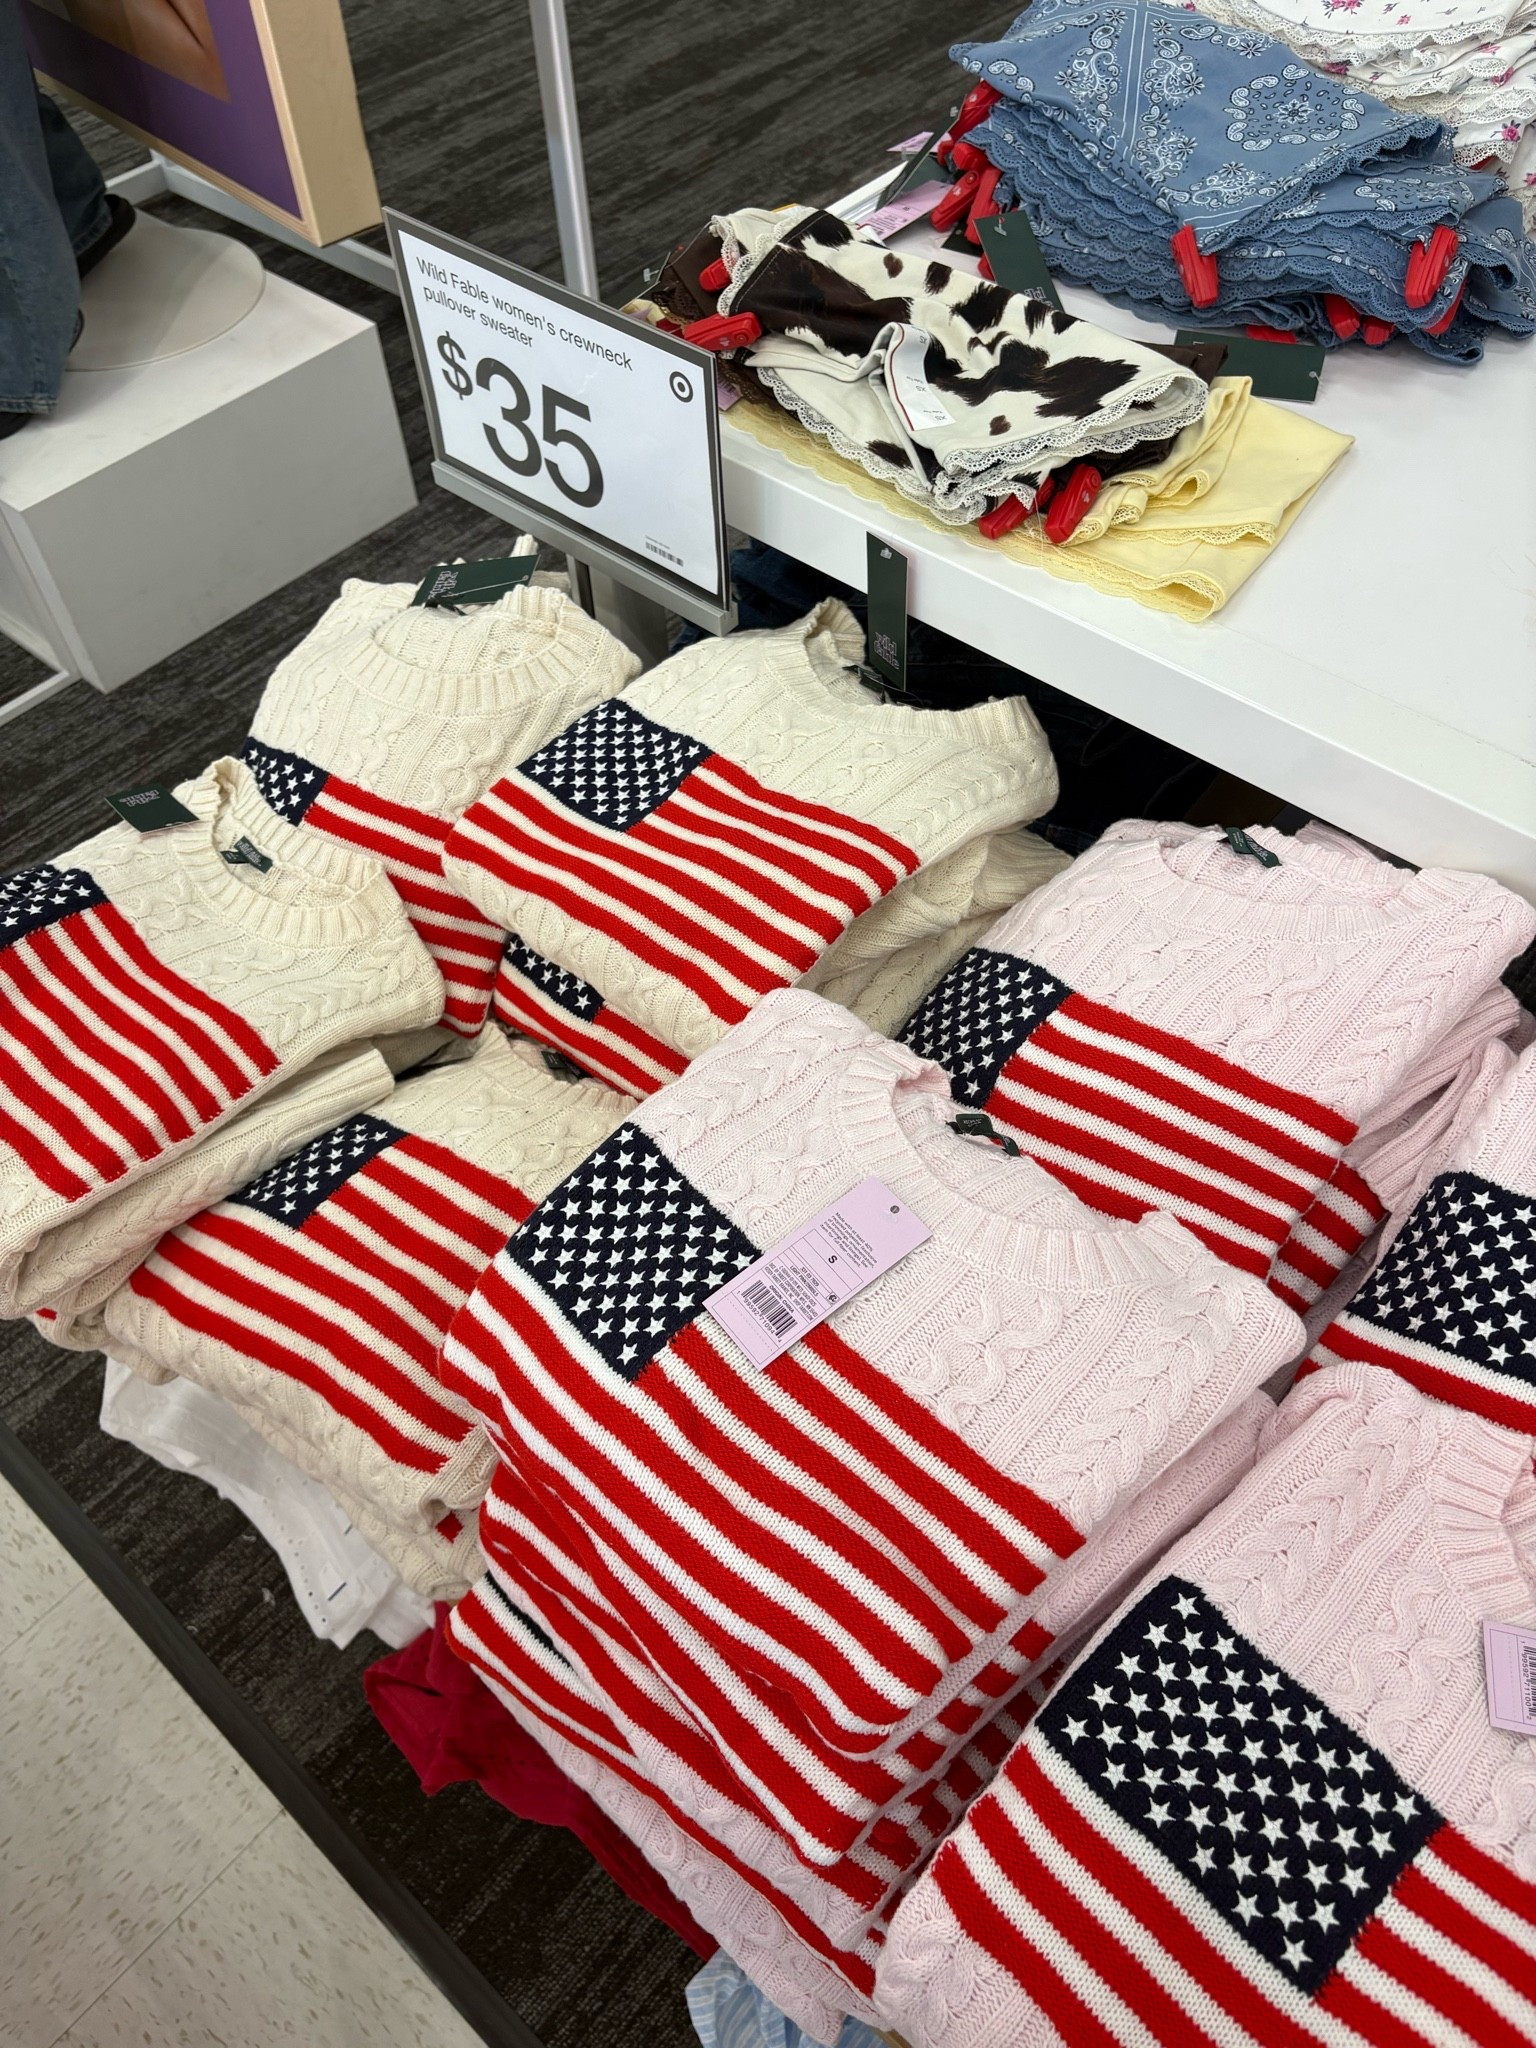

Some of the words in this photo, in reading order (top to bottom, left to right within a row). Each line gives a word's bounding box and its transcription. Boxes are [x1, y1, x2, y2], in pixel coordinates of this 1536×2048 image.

[416, 257, 448, 285] Wild
[450, 273, 489, 303] Fable
[492, 295, 555, 336] women's
[559, 328, 633, 371] crewneck
[423, 286, 476, 321] pullover
[480, 312, 533, 348] sweater
[436, 330, 604, 509] $35
[819, 1223, 828, 1233] item
[837, 1243, 848, 1253] fiber
[830, 1215, 846, 1230] recycled
[844, 1229, 861, 1246] polyester
[834, 1212, 845, 1222] Made
[843, 1221, 853, 1230] with
[855, 1233, 865, 1243] least
[841, 1239, 849, 1247] and
[827, 1254, 838, 1264] S
[742, 1298, 759, 1316] 99592
[758, 1316, 775, 1334] 71094
[781, 1299, 795, 1313] CHINA
[1524, 1682, 1532, 1707] 71100
